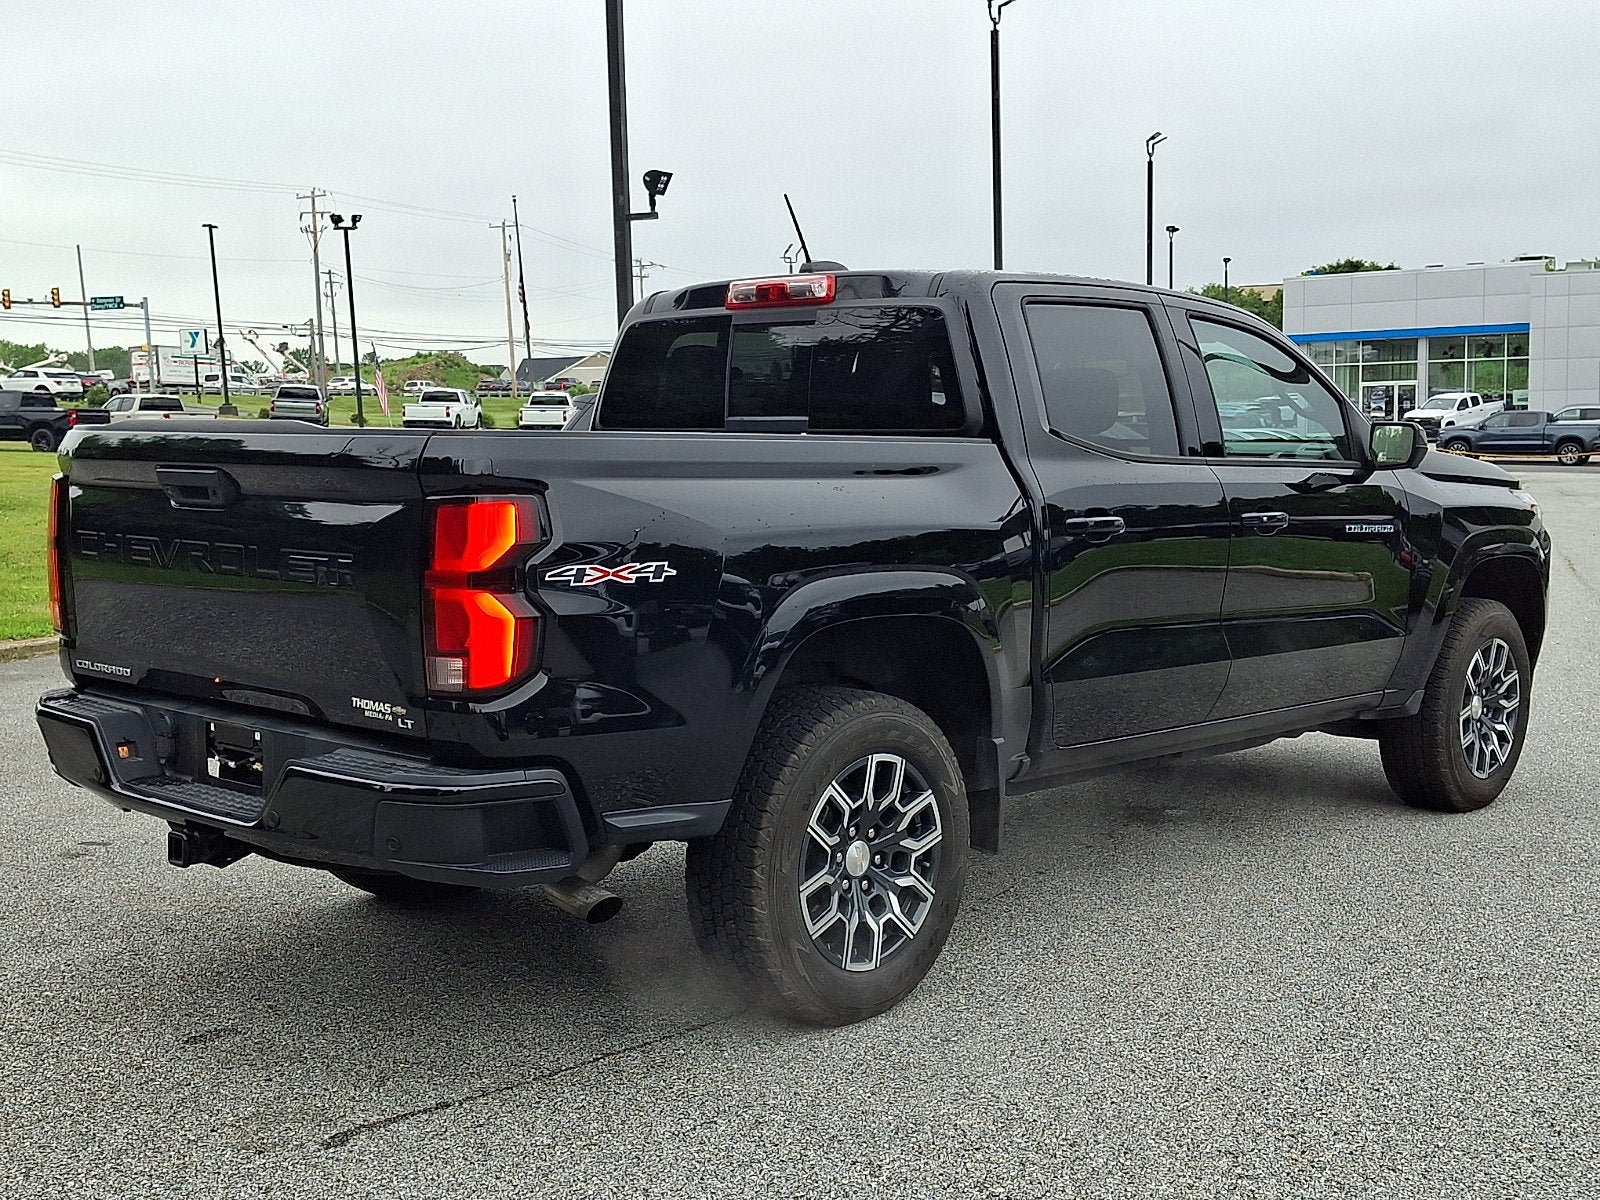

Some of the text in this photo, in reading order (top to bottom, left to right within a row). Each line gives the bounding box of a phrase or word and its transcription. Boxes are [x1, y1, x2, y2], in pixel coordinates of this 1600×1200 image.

[76, 530, 354, 587] CHEVROLET
[76, 659, 131, 677] COLORADO
[351, 696, 391, 714] THOMAS
[384, 714, 393, 722] PA
[397, 718, 414, 730] LT
